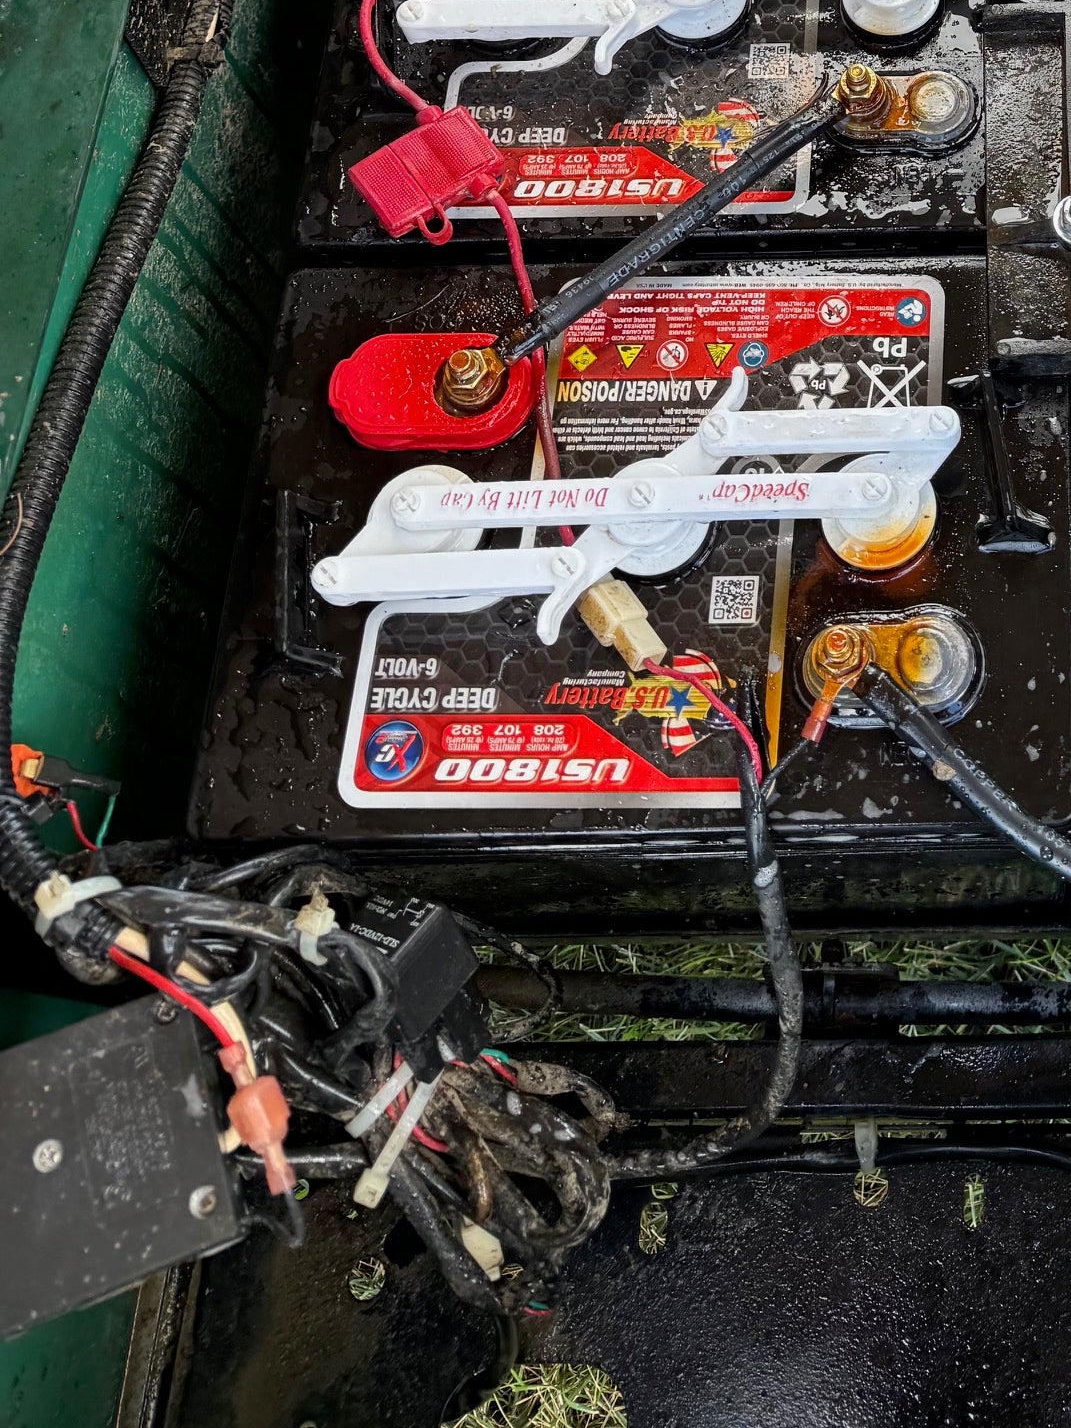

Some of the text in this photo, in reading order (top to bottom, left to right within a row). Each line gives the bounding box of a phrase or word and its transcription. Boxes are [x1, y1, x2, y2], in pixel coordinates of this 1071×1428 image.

[518, 127, 565, 143] DEEP
[607, 123, 680, 142] Battery
[528, 153, 627, 162] 208 107 392
[515, 178, 684, 199] US1800
[872, 337, 907, 358] Pb
[557, 381, 692, 402] DANGER/POISON
[811, 381, 826, 390] Pb
[441, 490, 474, 510] Cap
[478, 489, 502, 510] By
[507, 490, 543, 509] Lift
[551, 489, 577, 509] Not
[585, 486, 609, 509] Do
[375, 658, 437, 676] 6-VOLT
[587, 670, 625, 678] Company
[562, 677, 625, 686] Manufacturing
[371, 687, 496, 709] DEEP CYCLE
[544, 682, 669, 710] U.S. Battery
[451, 725, 565, 735] 208 107 392
[448, 743, 480, 751] MINUTES
[489, 743, 521, 751] MINUTES
[526, 743, 569, 752] AMP HOURS
[433, 758, 630, 783] US1800
